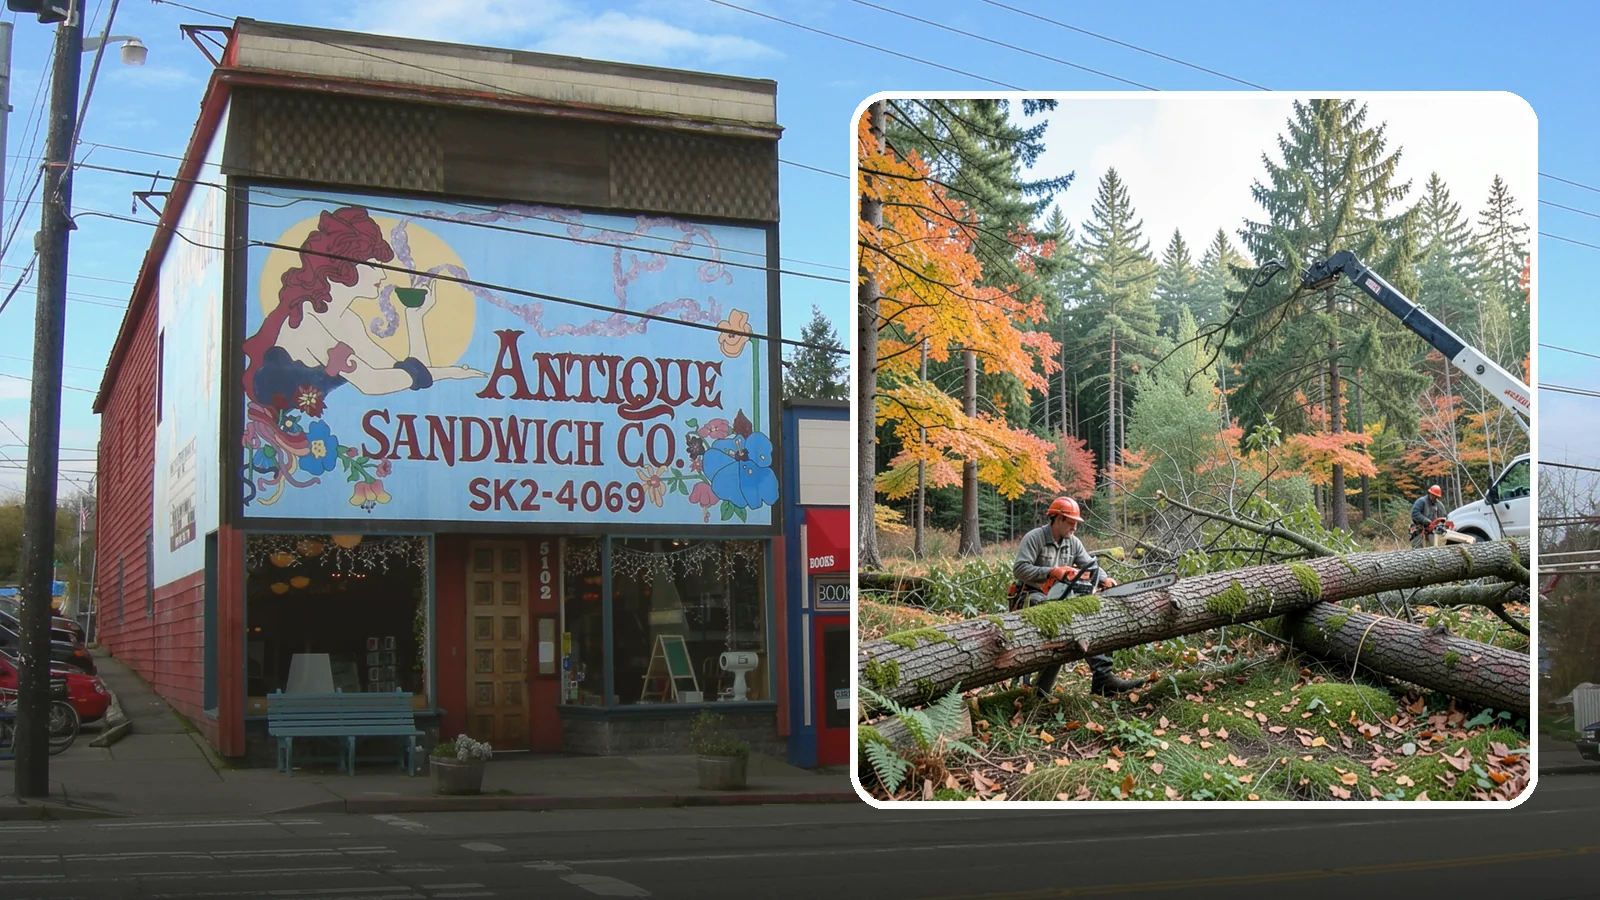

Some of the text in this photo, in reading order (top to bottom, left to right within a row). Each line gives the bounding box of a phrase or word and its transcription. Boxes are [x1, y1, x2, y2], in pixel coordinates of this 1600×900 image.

[477, 329, 724, 420] ANTIQUE
[361, 408, 685, 469] SANDWICH CO.
[468, 477, 646, 513] SK2-4069
[540, 541, 551, 600] 5102
[809, 555, 835, 569] BOOKS
